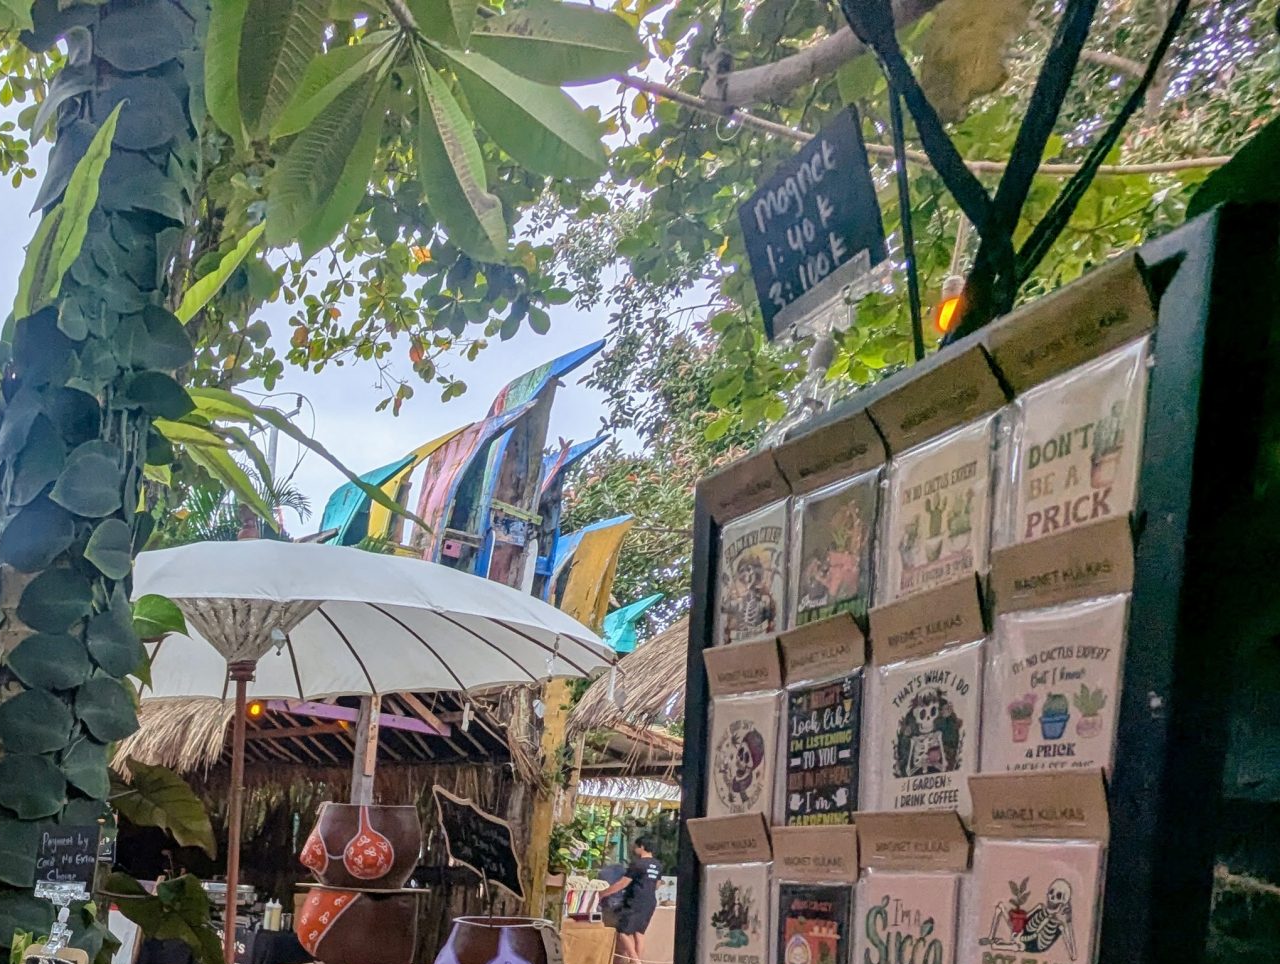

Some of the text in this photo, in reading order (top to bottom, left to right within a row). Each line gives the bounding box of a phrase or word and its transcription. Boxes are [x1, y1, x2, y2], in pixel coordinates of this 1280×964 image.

[1028, 423, 1095, 469] DON'T
[1030, 465, 1079, 498] BE A
[1025, 487, 1111, 537] PRICK
[1040, 645, 1074, 663] CACTUS
[1076, 645, 1111, 660] EXPERT
[892, 675, 921, 708] THAT'S
[924, 669, 950, 685] WHAT
[956, 678, 969, 695] DO
[792, 705, 851, 737] Look like
[806, 729, 852, 749] LISTENING
[803, 746, 837, 769] TO YOU
[1036, 742, 1076, 758] PRICK
[912, 775, 946, 791] GARDEN
[900, 793, 926, 808] DRINK
[928, 789, 958, 805] COFFEE
[913, 912, 920, 925] A
